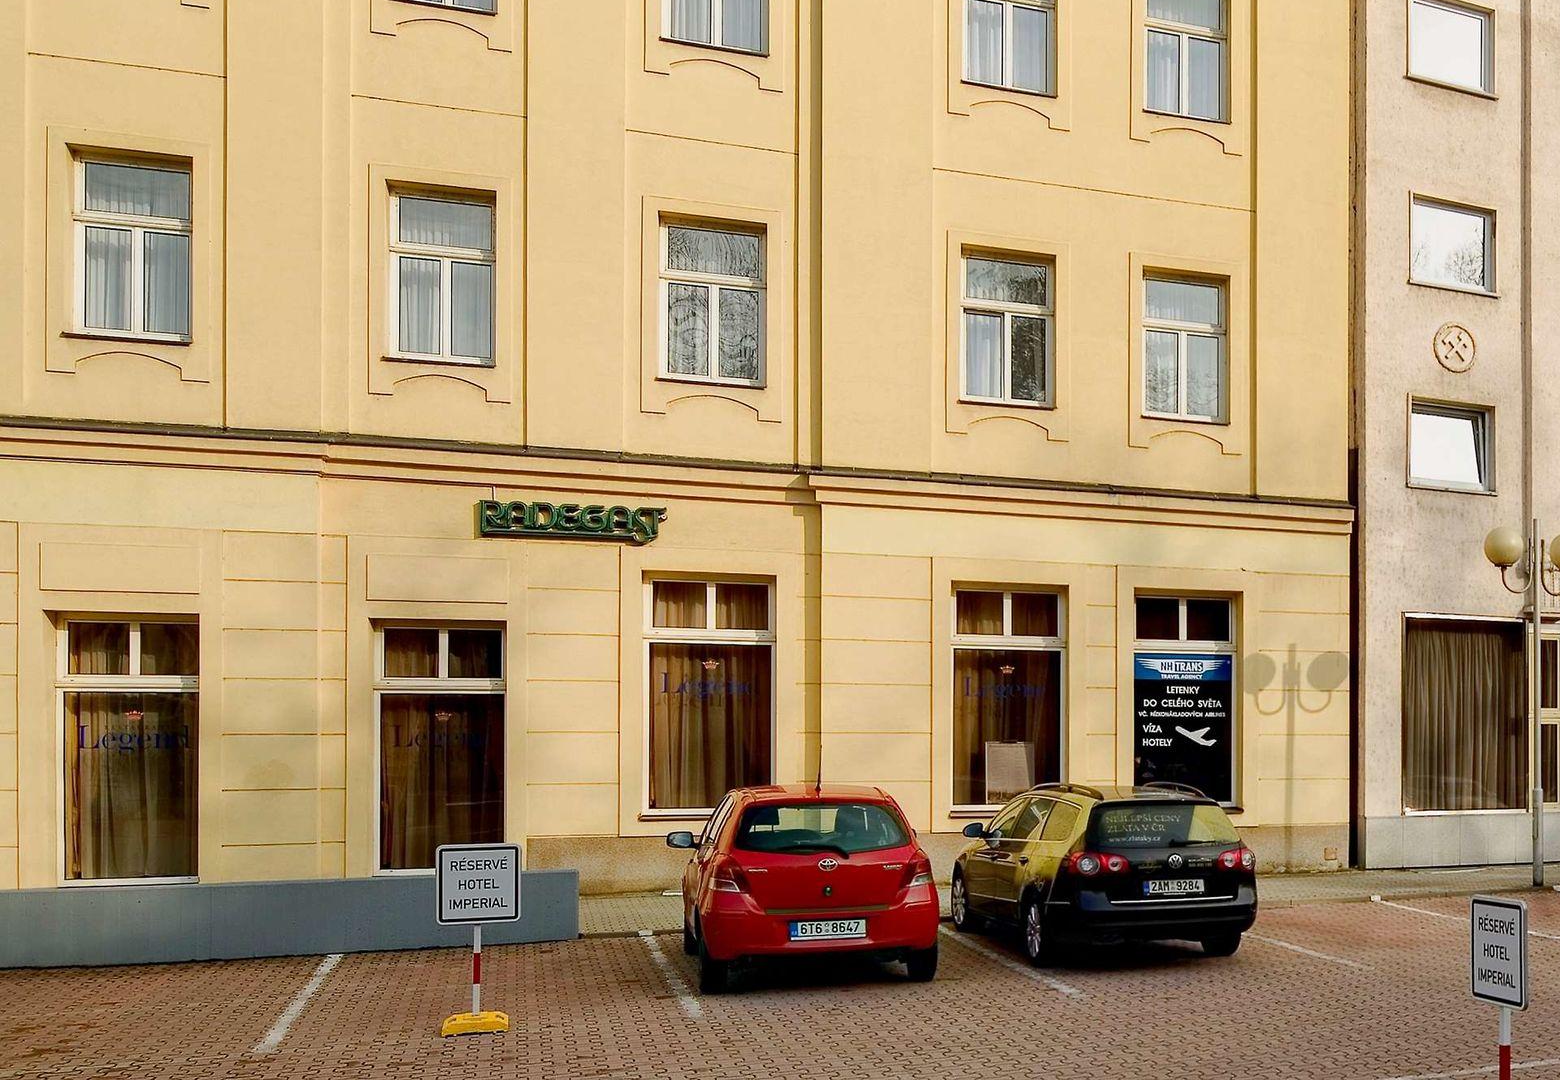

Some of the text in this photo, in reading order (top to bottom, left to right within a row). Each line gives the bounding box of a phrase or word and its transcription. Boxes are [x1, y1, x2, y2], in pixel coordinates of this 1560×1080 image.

[479, 499, 667, 546] RADEGAST
[1160, 661, 1204, 672] NH TRANS
[1166, 685, 1200, 694] LETENKY
[1143, 697, 1222, 708] DO CELÉHO SVĚTA
[1142, 722, 1162, 733] VÍZA
[1142, 738, 1173, 747] HOTELY
[450, 855, 508, 872] RÉSERVÉ
[458, 878, 500, 891] HOTEL
[1151, 880, 1200, 892] 2AM 9284
[449, 897, 508, 910] IMPERIAL
[800, 921, 860, 935] 6T6 8647
[1478, 913, 1516, 937] RÉSERVÉ
[1483, 942, 1511, 962] HOTEL
[1477, 967, 1517, 989] IMPERIAL
